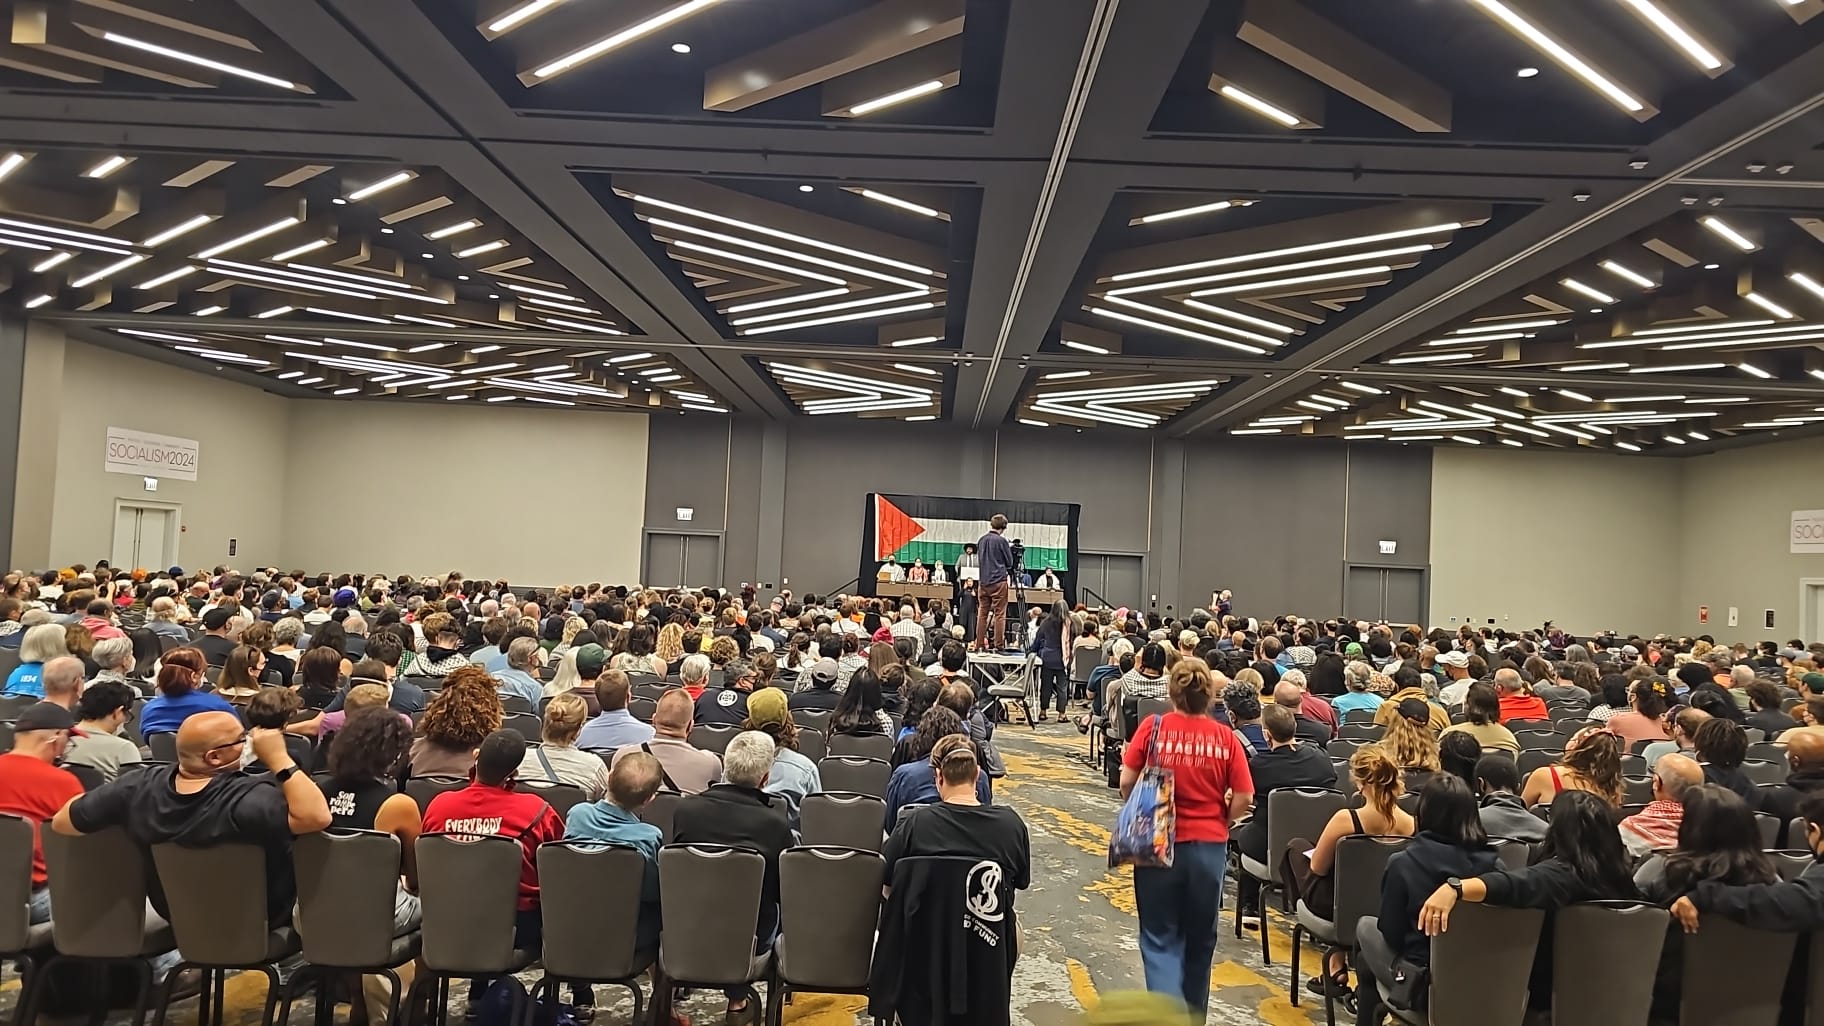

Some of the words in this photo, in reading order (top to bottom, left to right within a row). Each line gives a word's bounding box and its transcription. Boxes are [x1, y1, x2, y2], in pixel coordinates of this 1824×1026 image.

[109, 442, 194, 467] SOCIALISM2024
[445, 817, 502, 835] EVERYBODY
[973, 925, 997, 947] FUND
